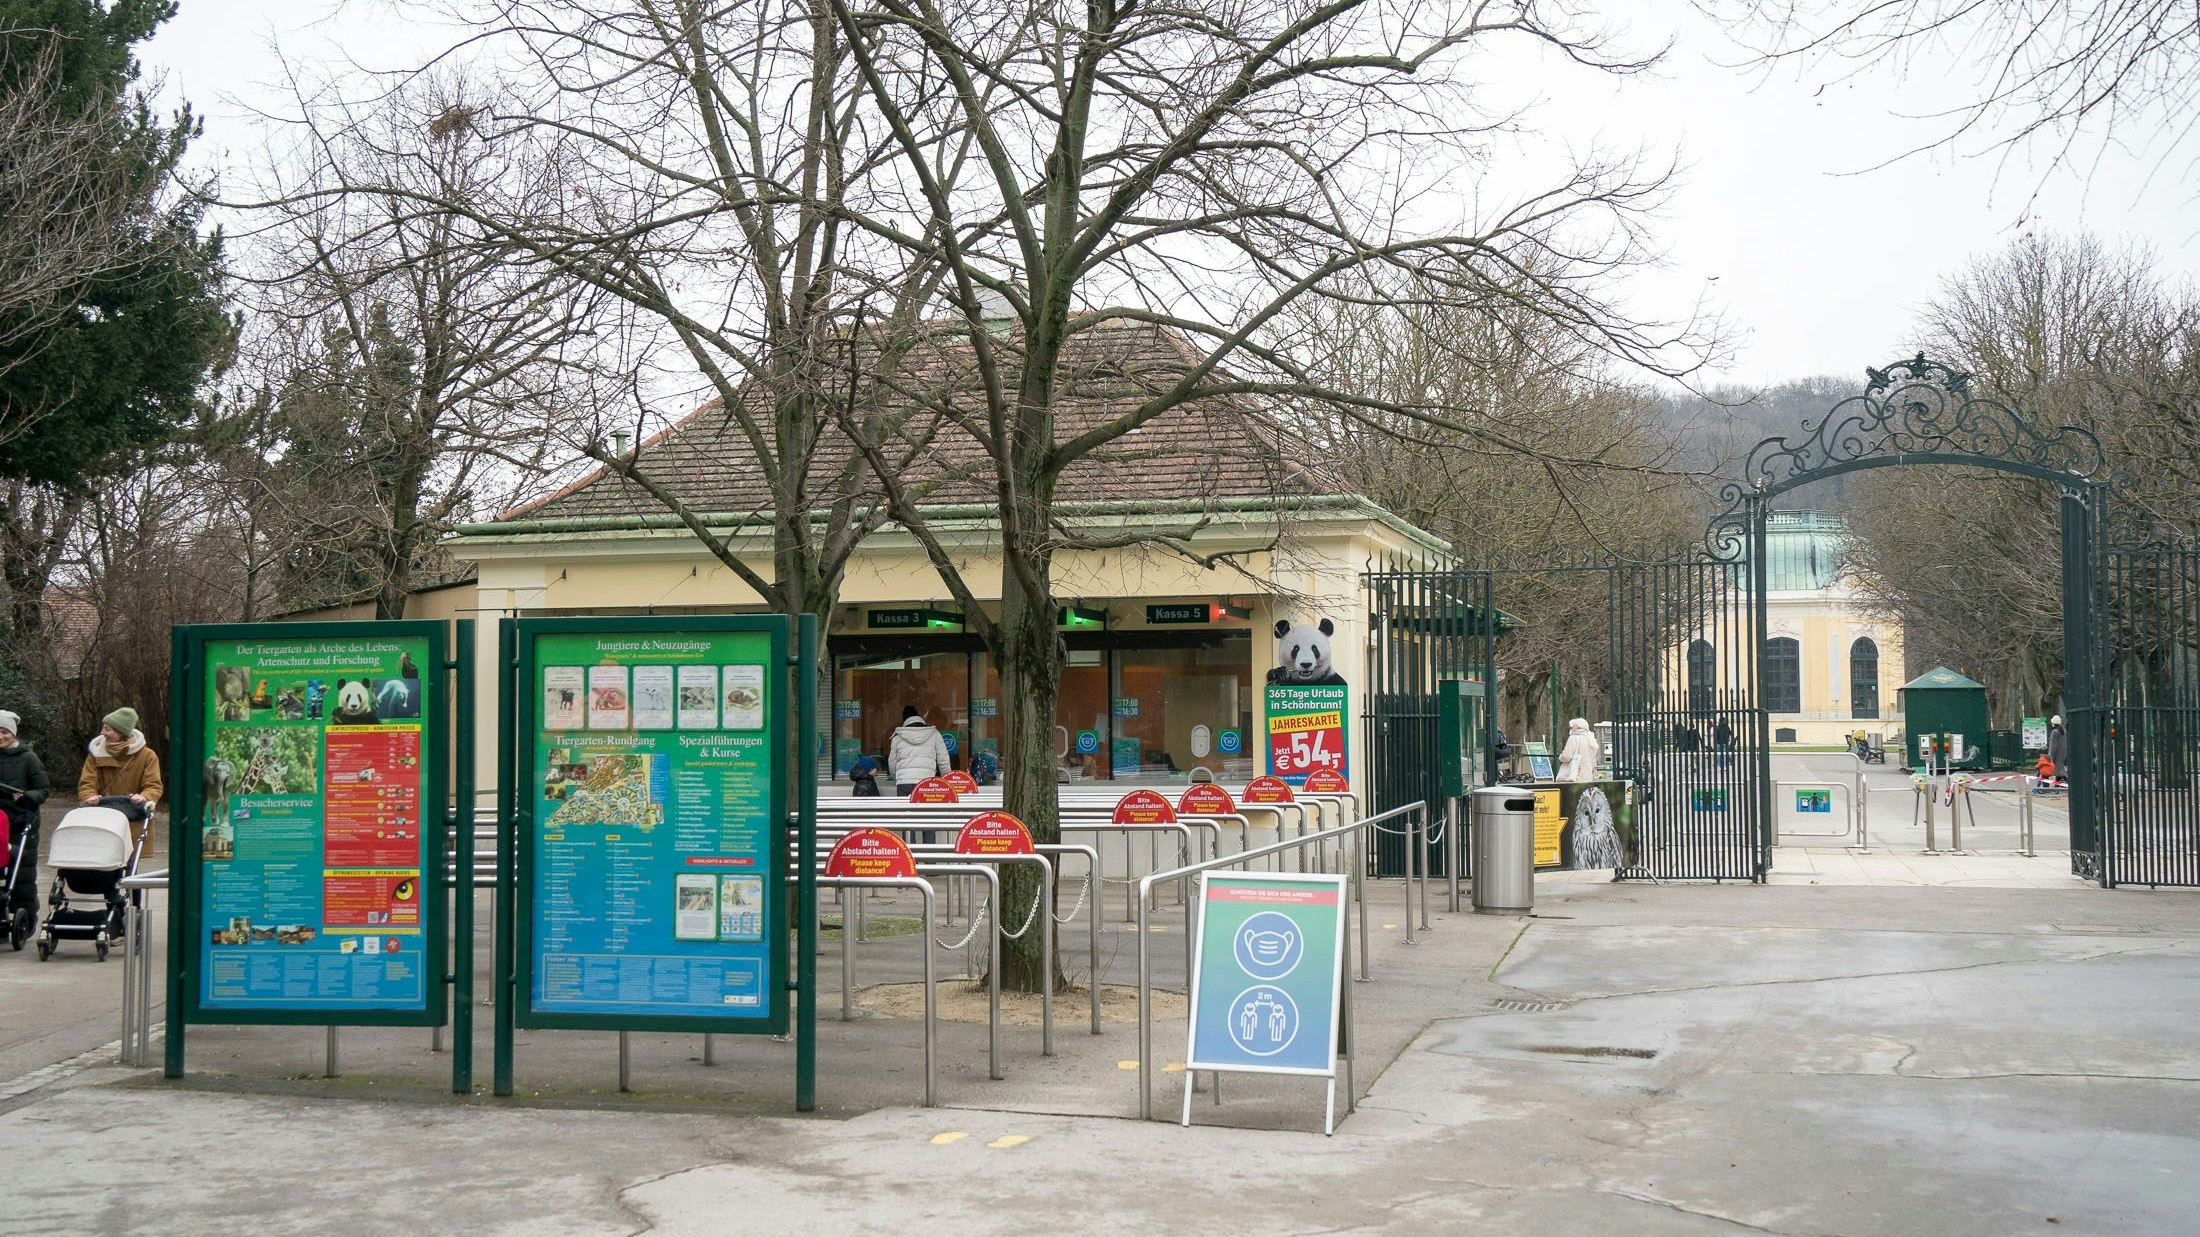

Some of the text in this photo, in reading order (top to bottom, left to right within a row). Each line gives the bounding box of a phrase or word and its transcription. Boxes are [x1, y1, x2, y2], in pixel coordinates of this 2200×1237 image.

[877, 613, 920, 623] Kassa 3
[1156, 608, 1201, 619] Kassa 5
[237, 646, 253, 655] Der
[256, 645, 301, 656] Tiergarten
[319, 644, 346, 653] Arche
[349, 643, 364, 652] des
[366, 642, 401, 651] Lebens:
[596, 640, 711, 652] Jungtiere & Neuzugänge
[257, 655, 380, 666] Artenschutz und Forschung
[1269, 689, 1344, 700] 365 Tage Urlaub
[981, 699, 996, 707] 17:00
[1271, 699, 1342, 710] in Schönbrunn!
[1272, 714, 1338, 730] JAHRESKARTE
[554, 736, 656, 748] Tiergarten-Rundgang
[679, 735, 762, 747] Spezialführungen
[700, 748, 740, 757] & Kurse
[1274, 746, 1290, 755] Jetzt
[1276, 755, 1290, 769] €
[240, 798, 313, 807] Besucherservice
[874, 859, 890, 867] keep
